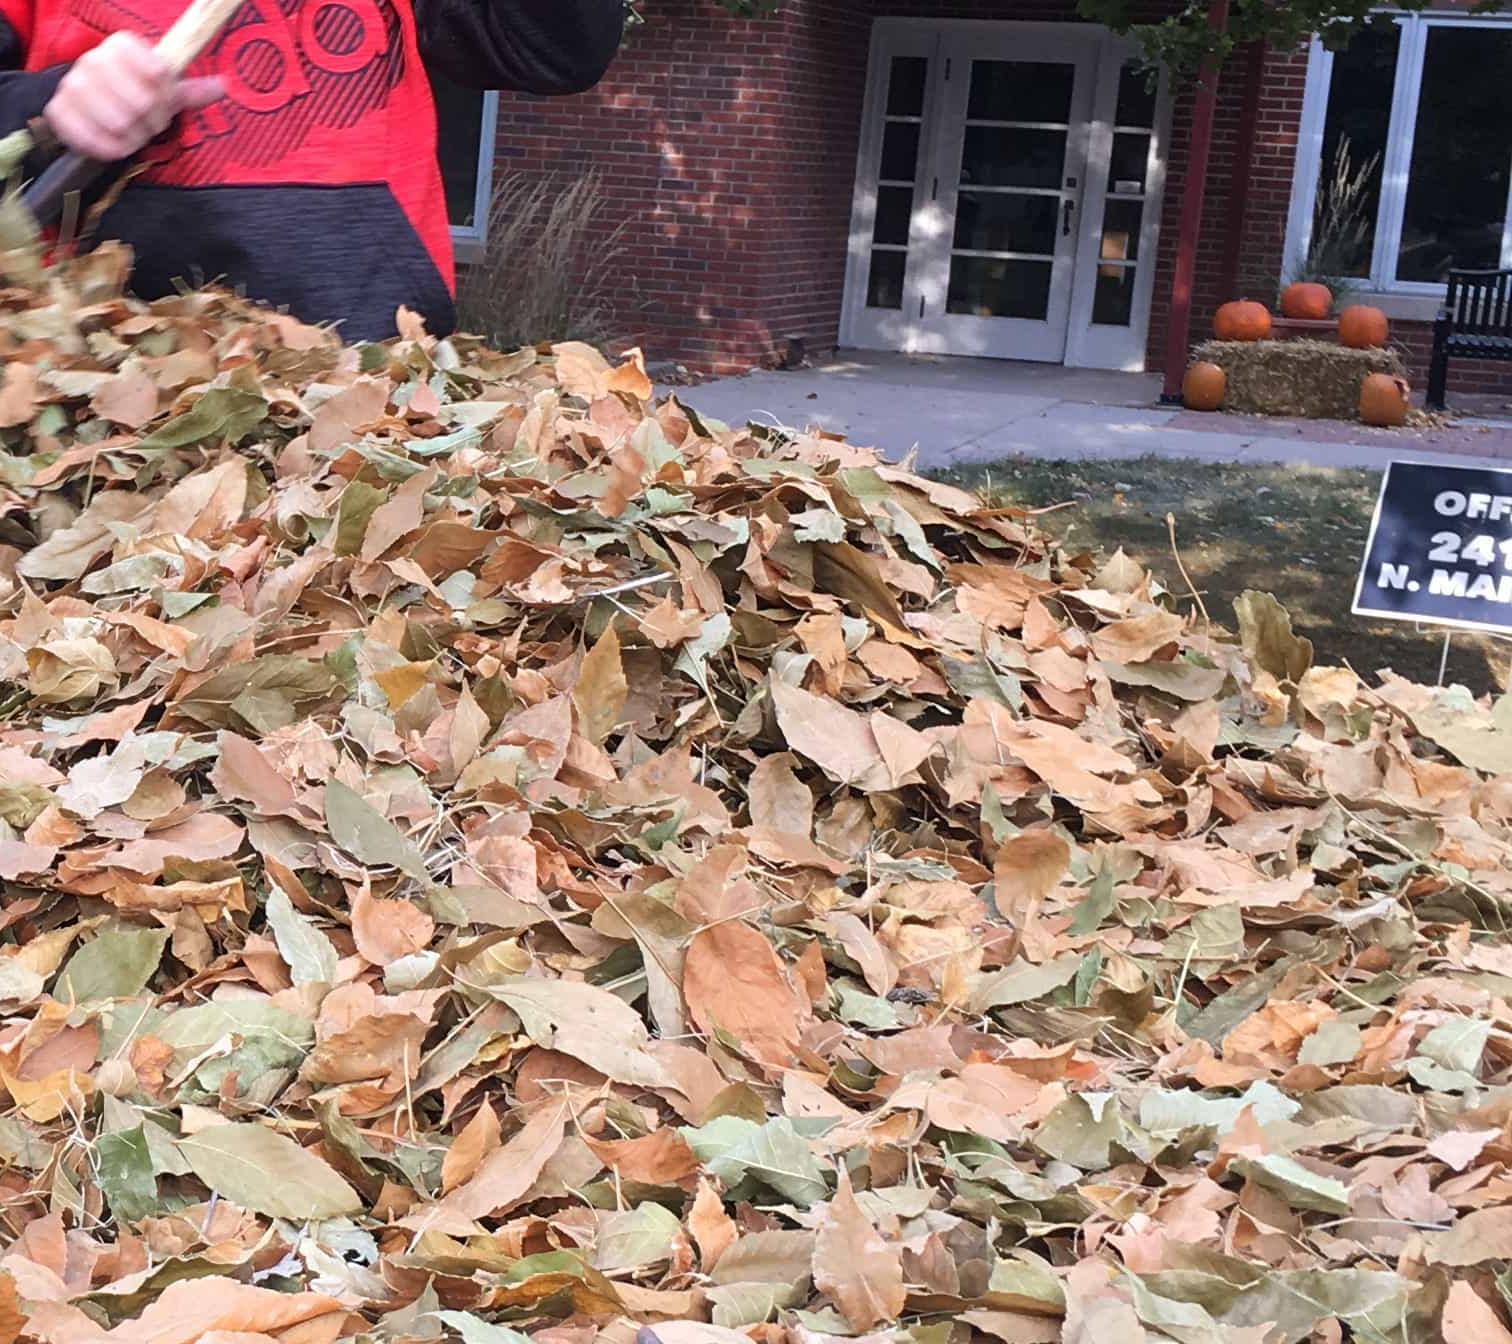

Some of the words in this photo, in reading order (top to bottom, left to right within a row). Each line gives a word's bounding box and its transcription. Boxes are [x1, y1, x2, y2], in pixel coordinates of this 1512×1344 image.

[1434, 491, 1512, 522] OFF
[1377, 562, 1420, 592] N.
[1428, 569, 1512, 603] MAI
